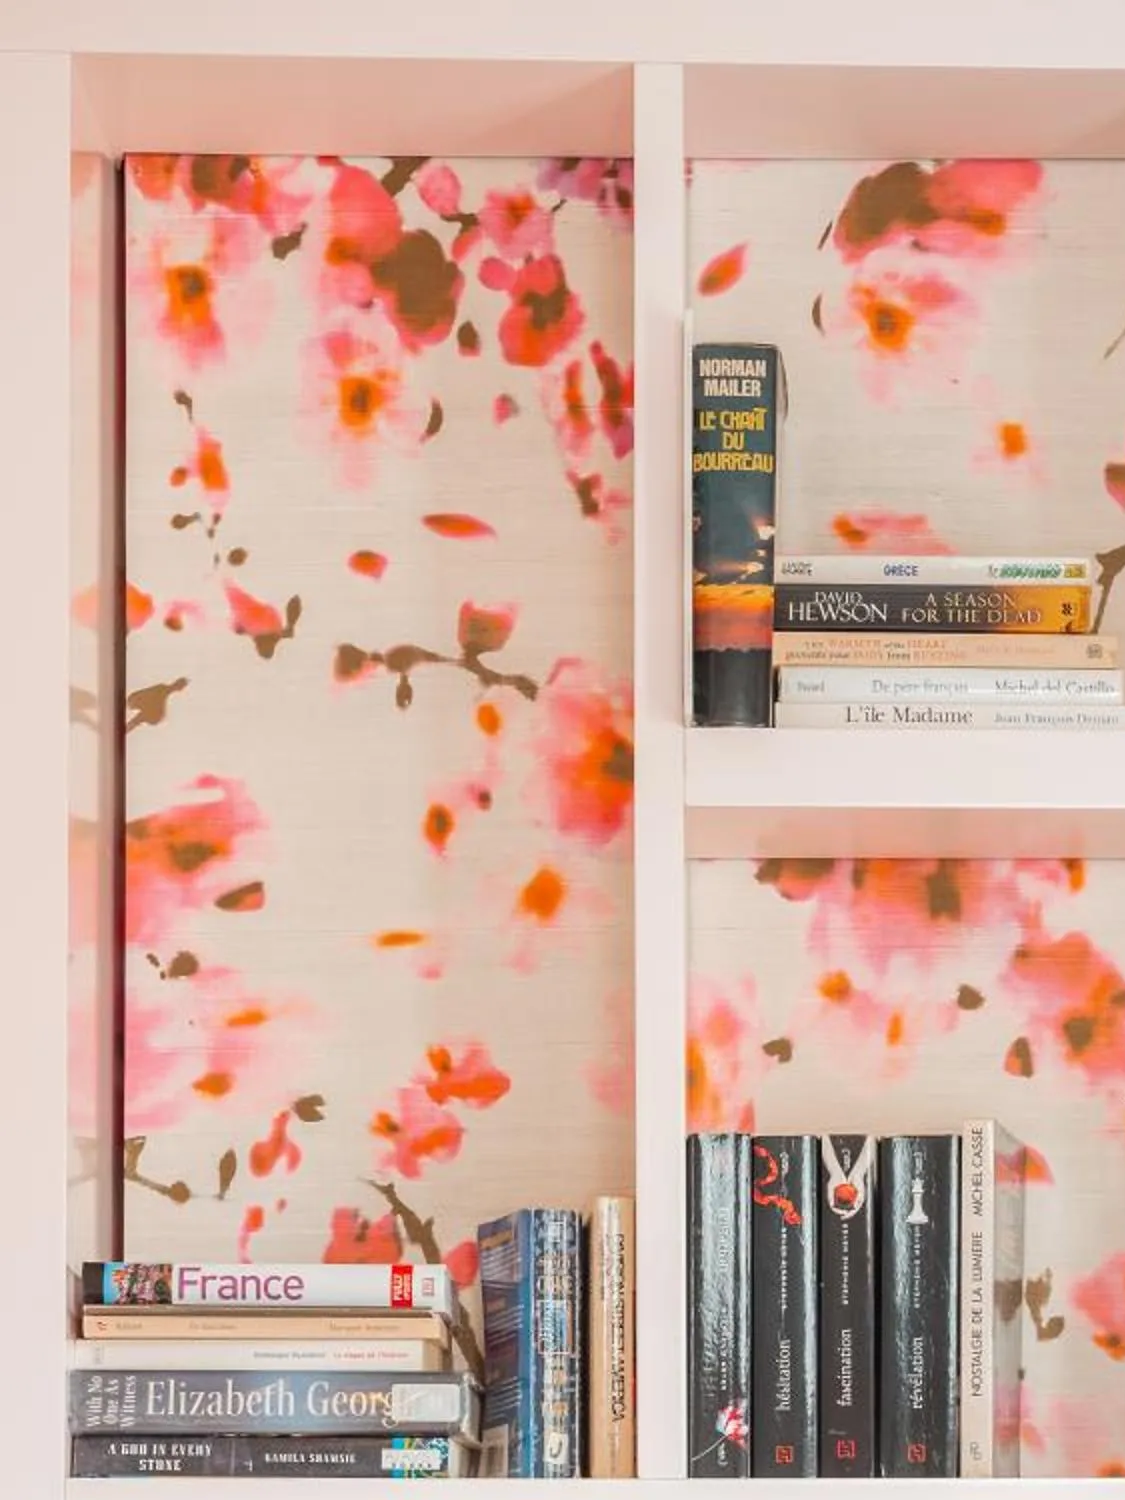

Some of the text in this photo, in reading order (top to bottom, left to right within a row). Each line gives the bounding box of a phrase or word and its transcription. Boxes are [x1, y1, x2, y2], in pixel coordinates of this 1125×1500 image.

[699, 358, 767, 377] NORMAN
[703, 379, 762, 397] MAILER
[700, 406, 768, 431] LE CHANT
[722, 431, 745, 450] DU
[692, 451, 774, 473] BOURREAU
[815, 591, 863, 605] DAVID
[925, 591, 1018, 607] A SEASON
[789, 601, 888, 623] HEWSON
[901, 607, 1041, 623] FOR THE DEAD
[994, 679, 1038, 693] Michel
[892, 705, 974, 723] Madame
[971, 1171, 984, 1217] MICHEL
[177, 1266, 305, 1301] France
[971, 1287, 984, 1304] LA
[971, 1308, 984, 1325] DE
[836, 1328, 853, 1407] fascination
[909, 1336, 924, 1410] révélation
[971, 1329, 984, 1397] NOSTALGIE
[775, 1338, 792, 1412] hésitation
[85, 1375, 103, 1428] With No
[102, 1379, 120, 1425] One As
[119, 1375, 137, 1427] Witness
[146, 1378, 398, 1425] Elizabeth Georg
[107, 1443, 117, 1456] A
[152, 1443, 166, 1456] IN
[171, 1443, 211, 1457] EVERY
[139, 1458, 182, 1471] STONE
